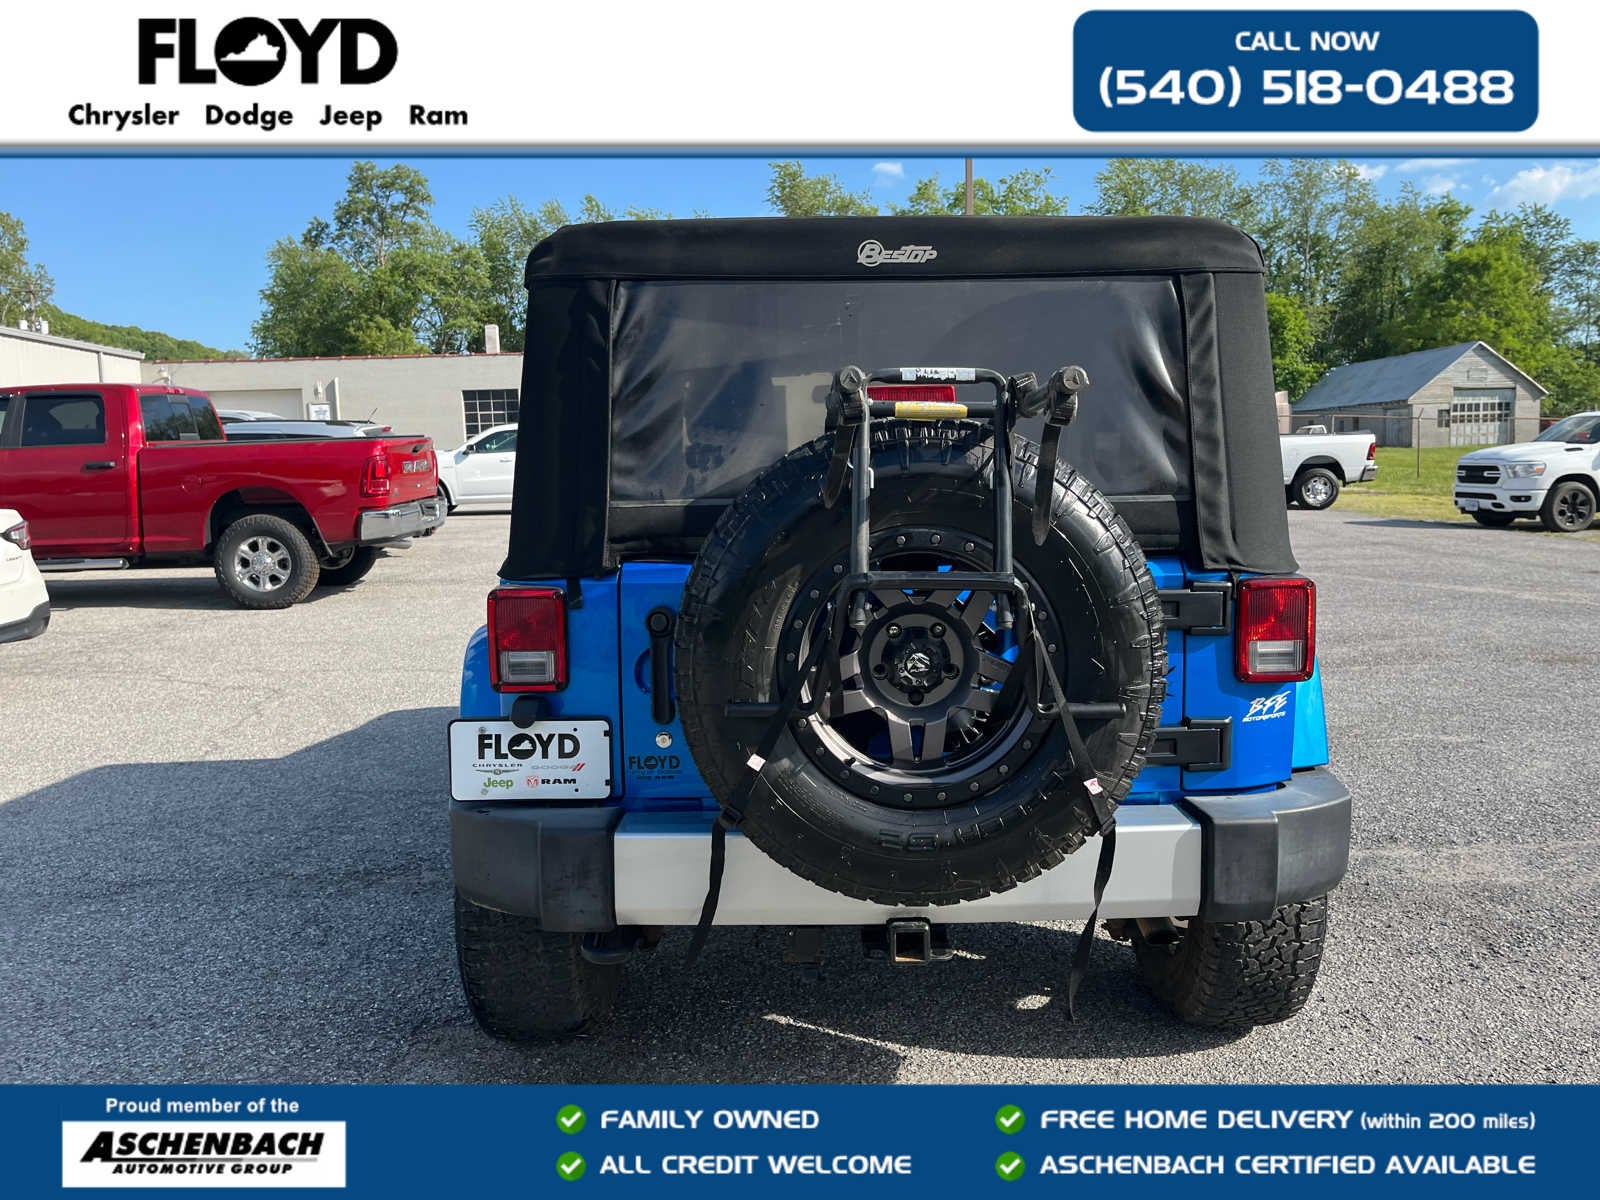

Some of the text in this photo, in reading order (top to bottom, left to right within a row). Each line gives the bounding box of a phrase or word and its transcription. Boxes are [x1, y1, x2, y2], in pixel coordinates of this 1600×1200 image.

[477, 732, 581, 760] FLOYD
[628, 755, 681, 770] FLOYD
[483, 777, 514, 789] Jeep
